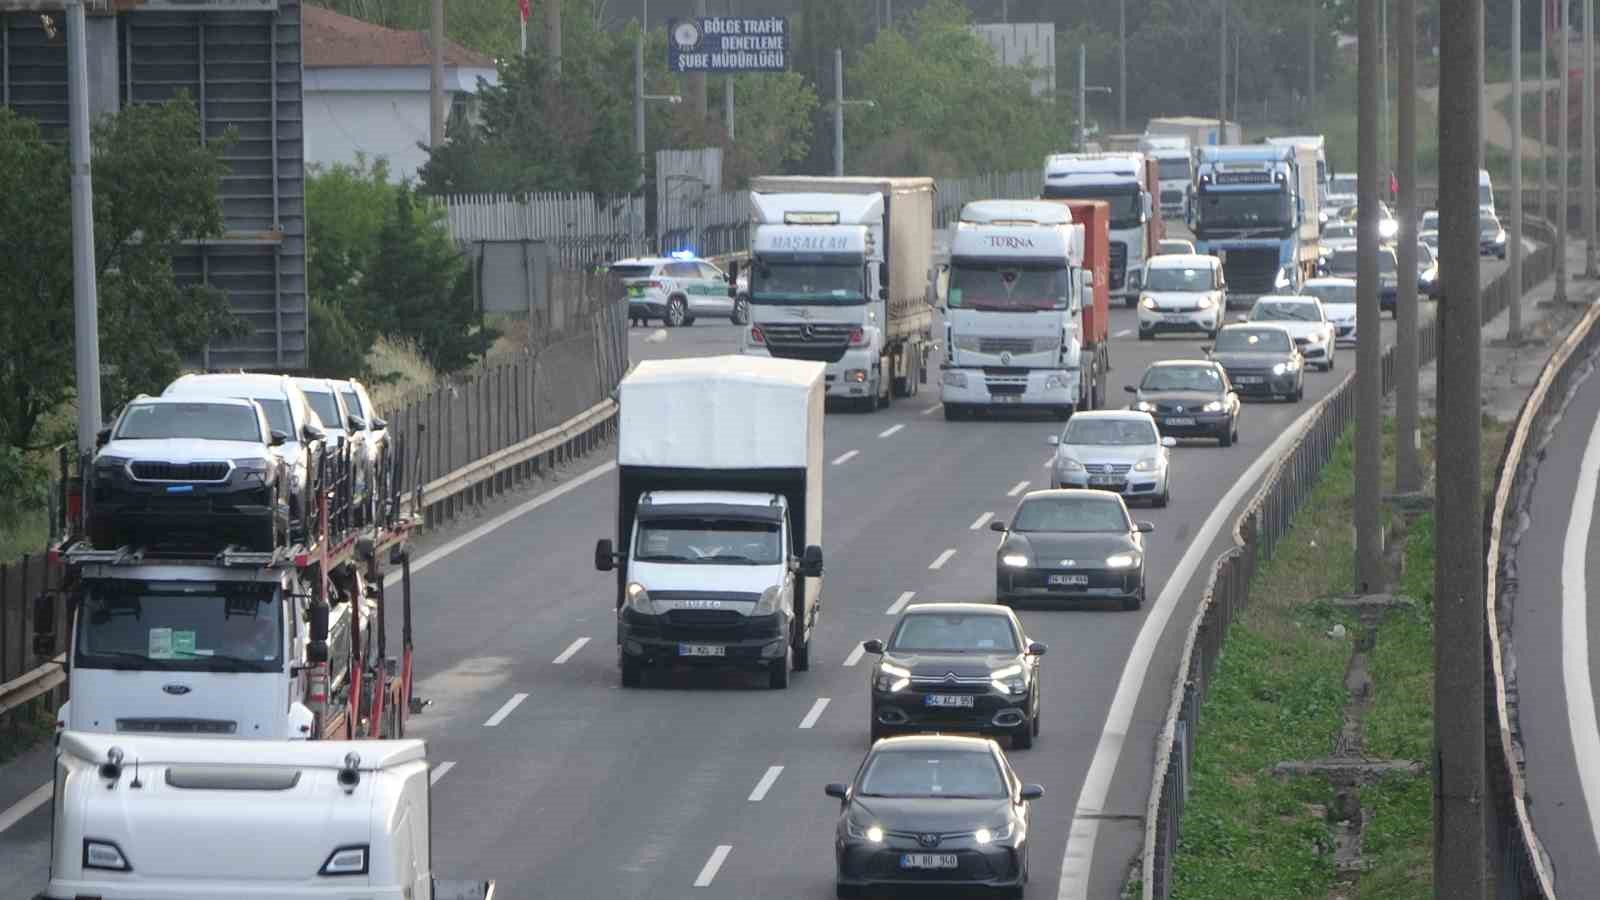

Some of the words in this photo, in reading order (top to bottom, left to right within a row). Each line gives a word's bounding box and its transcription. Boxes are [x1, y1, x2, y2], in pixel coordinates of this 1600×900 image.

[704, 17, 741, 33] BÖLGE
[743, 17, 784, 33] TRAFİK
[721, 36, 784, 50] DENETLEME
[679, 53, 708, 71] ŞUBE
[712, 50, 784, 68] MÜDÜRLÜĞÜ
[988, 235, 1034, 249] TURNA
